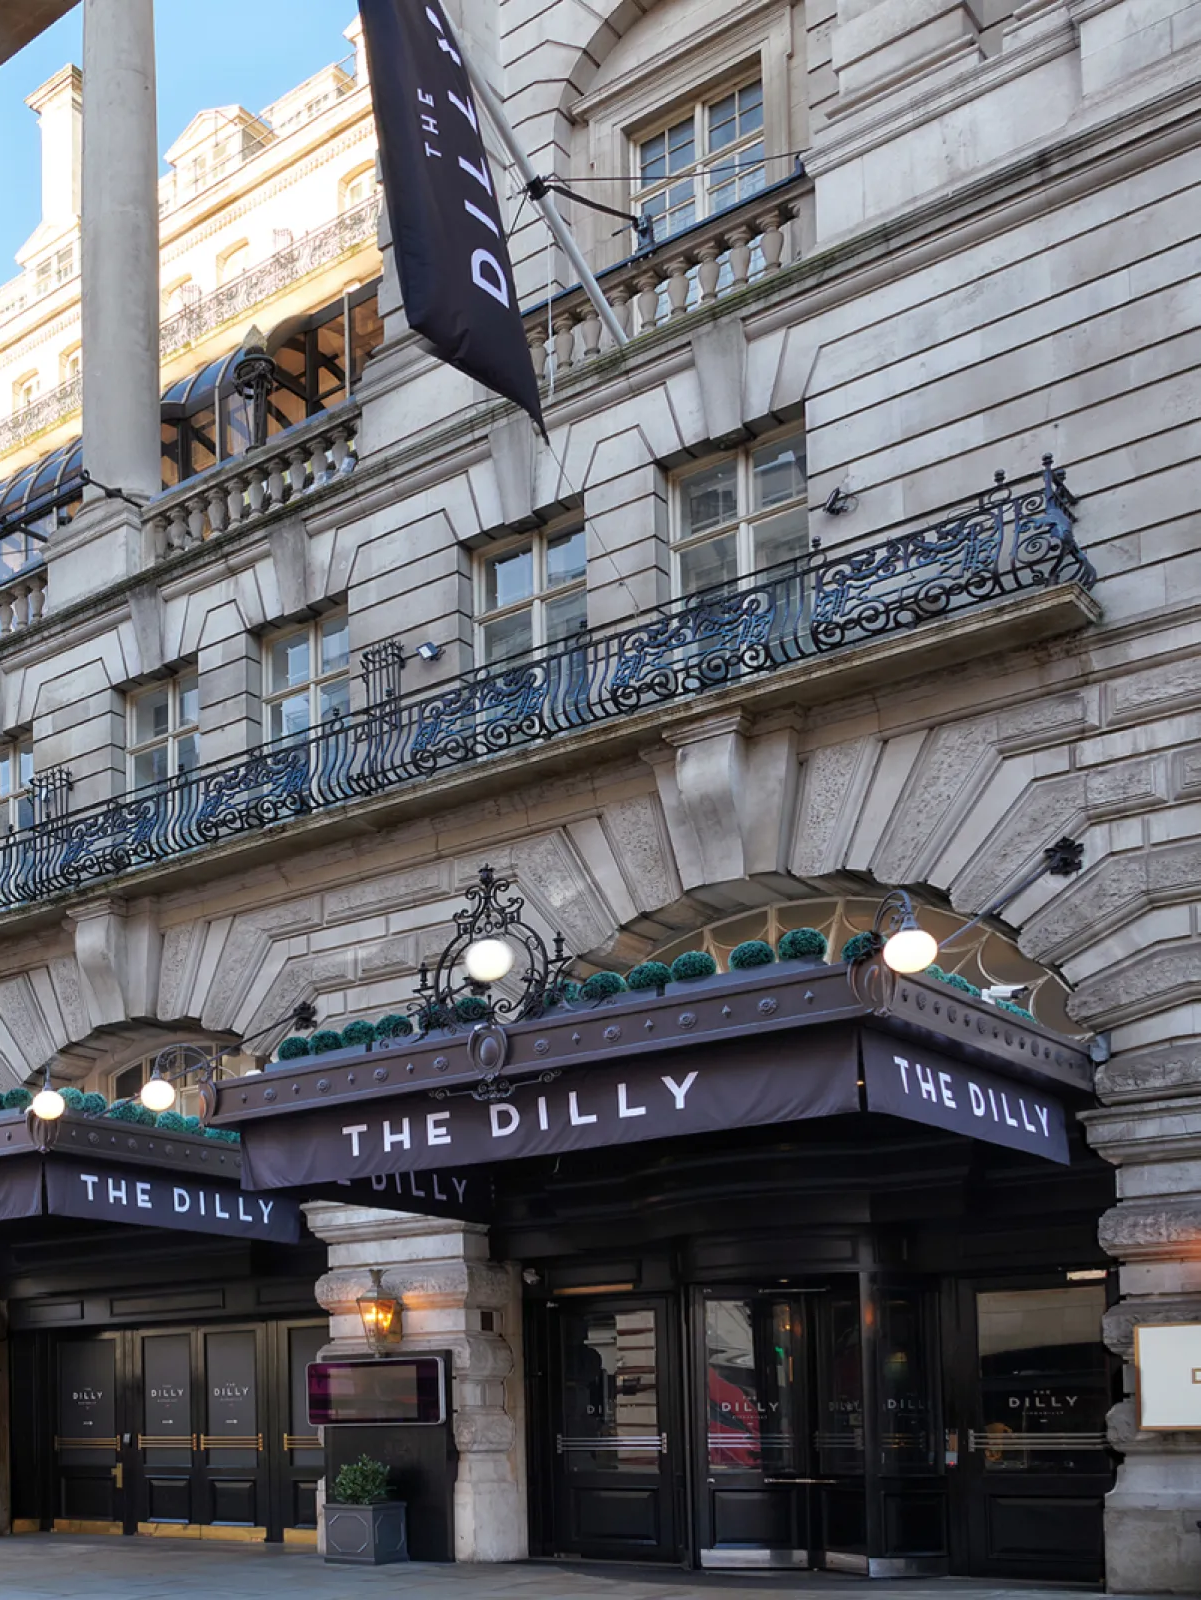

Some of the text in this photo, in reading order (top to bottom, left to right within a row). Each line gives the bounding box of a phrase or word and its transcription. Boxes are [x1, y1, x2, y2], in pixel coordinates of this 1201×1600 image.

[417, 87, 442, 158] THE
[893, 1055, 1049, 1137] THE DILLY
[342, 1071, 699, 1158] THE DILLY
[80, 1174, 275, 1226] THE DILLY
[72, 1391, 103, 1400] DILLY
[151, 1388, 184, 1398] DILLY
[214, 1386, 249, 1397] DILLY
[721, 1401, 779, 1412] DILLY
[887, 1398, 926, 1409] DILL
[1008, 1396, 1078, 1408] DILLY
